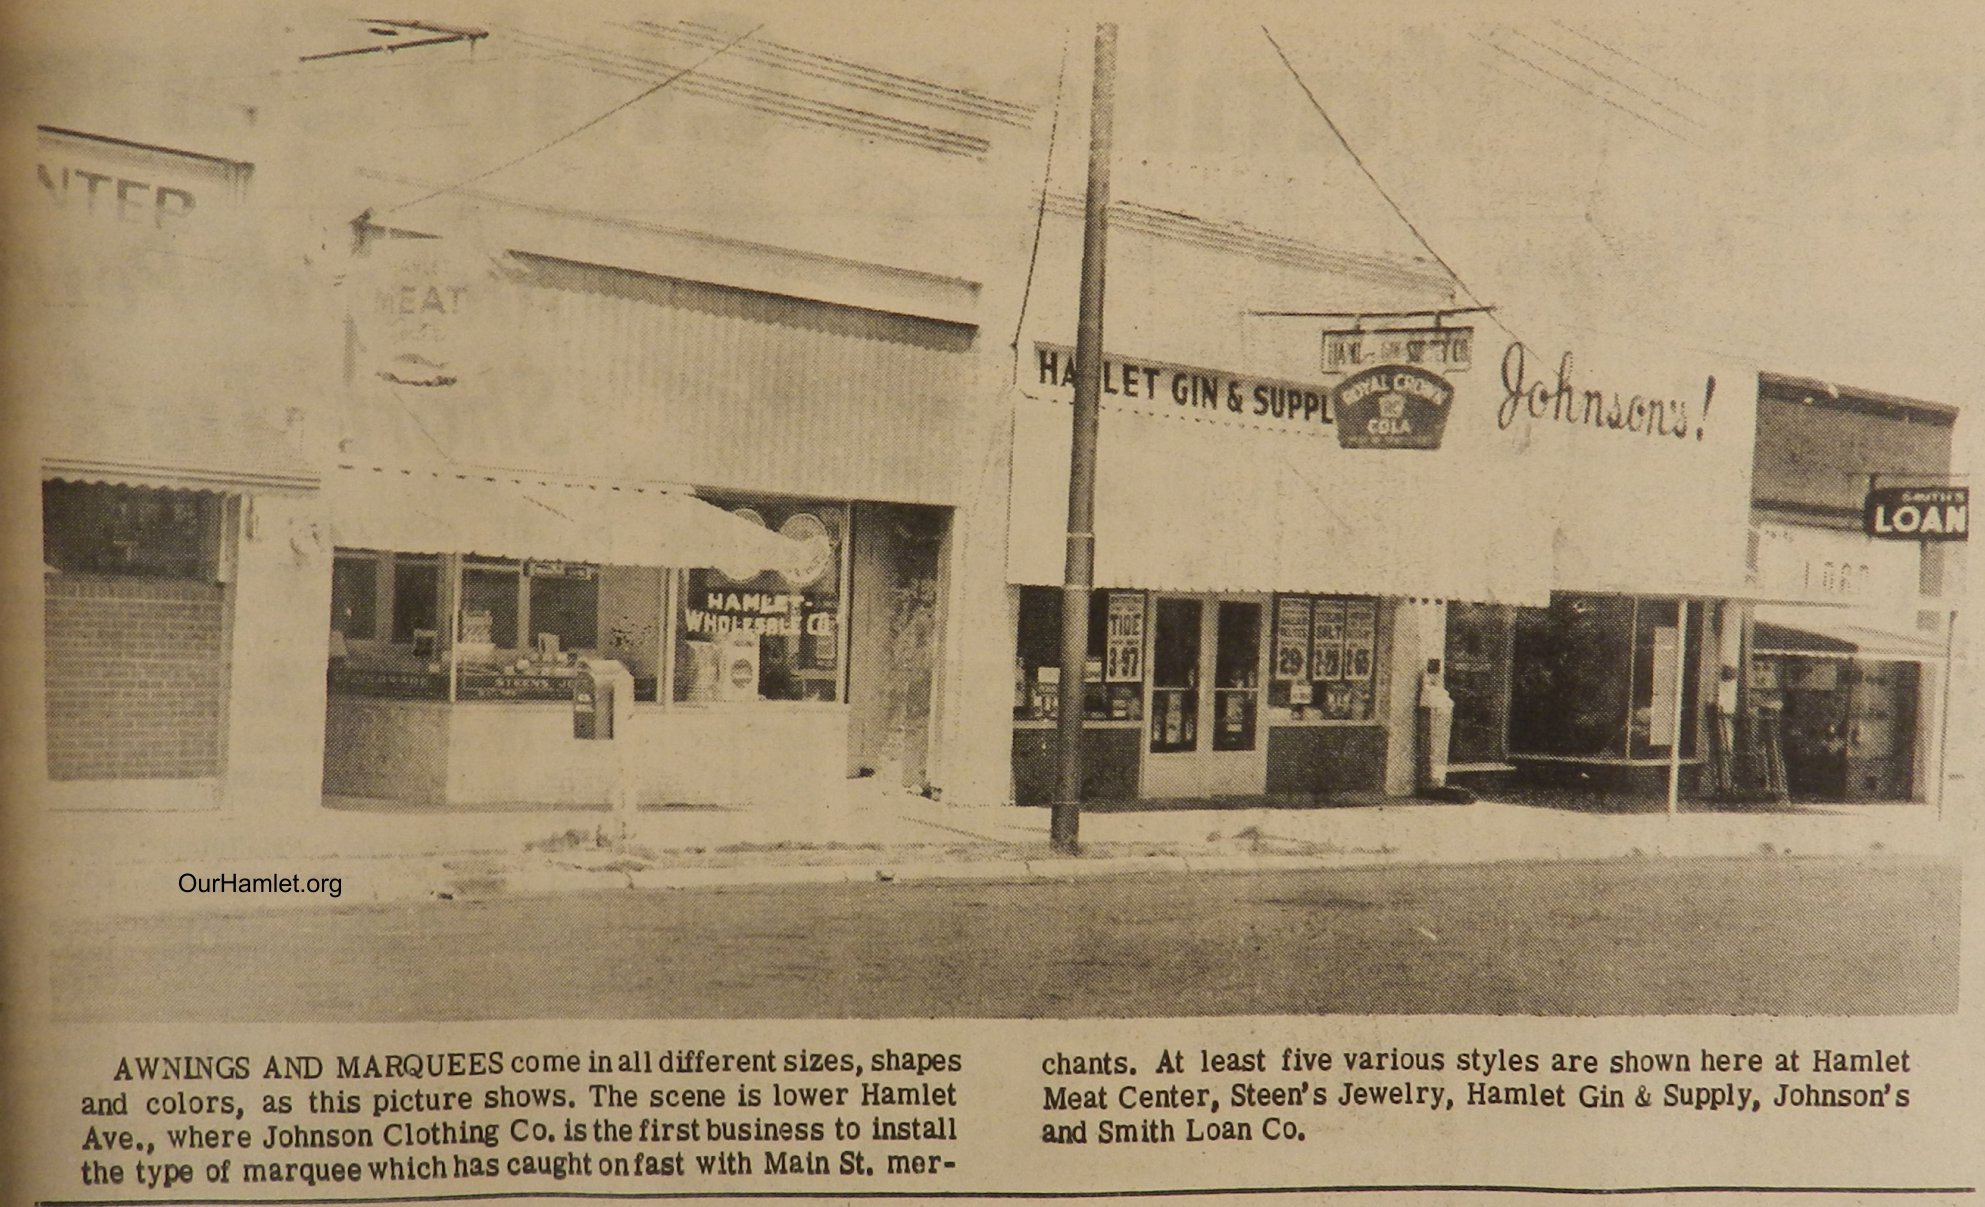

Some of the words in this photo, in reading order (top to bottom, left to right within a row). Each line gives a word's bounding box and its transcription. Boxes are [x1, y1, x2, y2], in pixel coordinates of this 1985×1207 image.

[1039, 350, 1160, 399] HALET
[1171, 373, 1219, 408] GIN
[1227, 383, 1245, 414] &
[1253, 385, 1334, 424] SUPPL
[1342, 374, 1390, 406] ROYAL
[1367, 418, 1412, 435] COLA
[1874, 505, 1967, 533] LOAN
[685, 609, 802, 636] WHOLESALE
[113, 1055, 251, 1082] AWNINGS
[262, 1054, 324, 1080] AND
[336, 1050, 504, 1080] MARQUEES
[510, 1054, 581, 1074] come
[587, 1049, 614, 1074] in
[617, 1050, 653, 1074] all
[658, 1049, 778, 1074] different
[783, 1048, 864, 1078] sizes,
[870, 1047, 963, 1077] shapes
[1041, 1051, 1138, 1076] chants.
[1154, 1048, 1185, 1075] At
[1200, 1048, 1267, 1073] least
[1281, 1046, 1333, 1072] five
[1342, 1046, 1446, 1073] various
[1456, 1047, 1540, 1078] styles
[1551, 1052, 1599, 1074] are
[1609, 1049, 1691, 1075] shown
[1700, 1048, 1763, 1073] here
[1774, 1049, 1801, 1073] at
[1812, 1048, 1911, 1074] Hamlet
[81, 1091, 129, 1117] and
[146, 1090, 245, 1121] colors,
[262, 1094, 293, 1115] as
[308, 1089, 362, 1115] this
[372, 1088, 473, 1118] picture
[483, 1084, 576, 1110] shows.
[588, 1083, 638, 1109] The
[649, 1088, 726, 1109] scene
[737, 1082, 762, 1108] is
[772, 1082, 850, 1107] lower
[860, 1082, 958, 1107] Hamlet
[1042, 1085, 1109, 1111] Meat
[1118, 1084, 1220, 1114] Center,
[1230, 1080, 1328, 1108] Steen's
[1337, 1081, 1454, 1112] Jewelry,
[1466, 1081, 1567, 1108] Hamlet
[1578, 1084, 1625, 1109] Gin
[1634, 1084, 1653, 1108] &
[1663, 1082, 1761, 1113] Supply,
[1772, 1082, 1911, 1108] Johnson's
[81, 1125, 155, 1156] Ave.,
[166, 1124, 252, 1150] where
[262, 1124, 374, 1150] Johnson
[382, 1119, 500, 1149] Clothing
[509, 1118, 556, 1144] Co.
[563, 1117, 588, 1143] is
[592, 1118, 633, 1144] the
[638, 1117, 701, 1143] first
[705, 1116, 825, 1142] business
[834, 1116, 861, 1142] to
[871, 1115, 958, 1141] install
[1039, 1119, 1088, 1145] and
[1097, 1118, 1176, 1145] Smith
[1185, 1118, 1253, 1143] Loan
[1261, 1116, 1306, 1142] Co.
[80, 1159, 125, 1186] the
[135, 1159, 194, 1190] type
[205, 1158, 232, 1184] of
[242, 1162, 362, 1187] marquee
[367, 1154, 448, 1182] which
[452, 1153, 500, 1179] has
[506, 1151, 593, 1181] caught
[598, 1156, 630, 1177] on
[633, 1150, 686, 1177] fast
[695, 1150, 753, 1177] with
[763, 1150, 831, 1176] Main
[839, 1150, 874, 1177] St.
[887, 1154, 956, 1175] mer-
